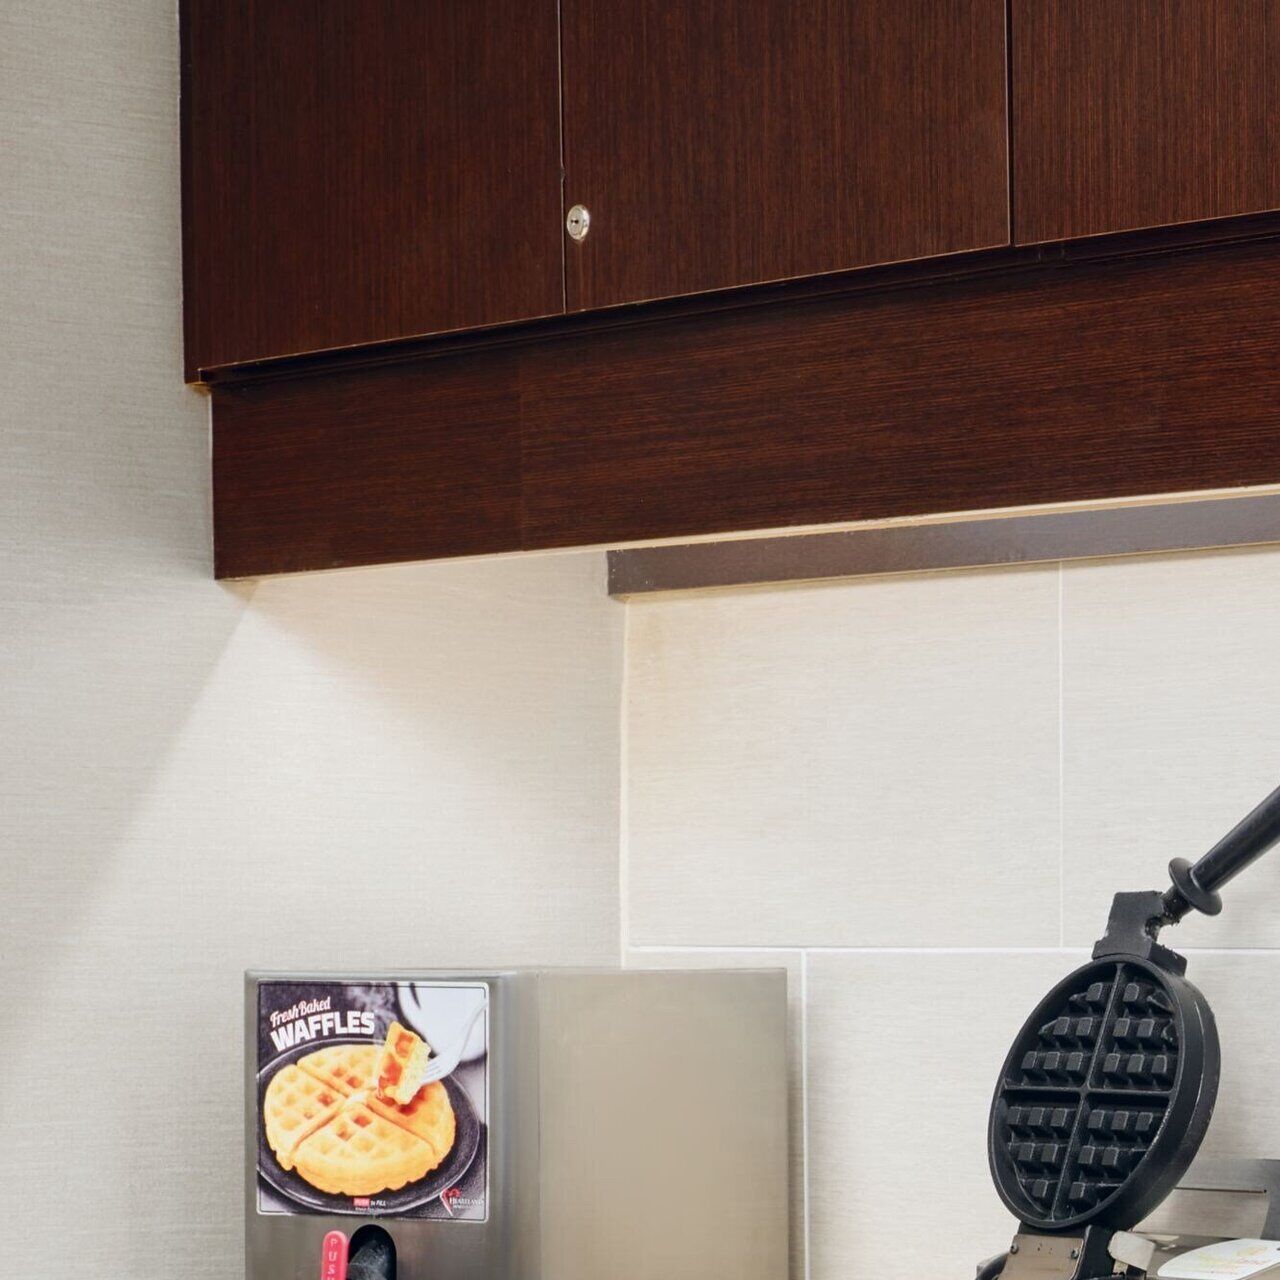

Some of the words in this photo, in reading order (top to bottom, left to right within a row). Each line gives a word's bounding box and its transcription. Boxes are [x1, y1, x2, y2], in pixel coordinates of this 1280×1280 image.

[270, 1004, 299, 1028] Fresh
[298, 996, 331, 1016] Baked
[270, 1010, 376, 1053] WAFFLES
